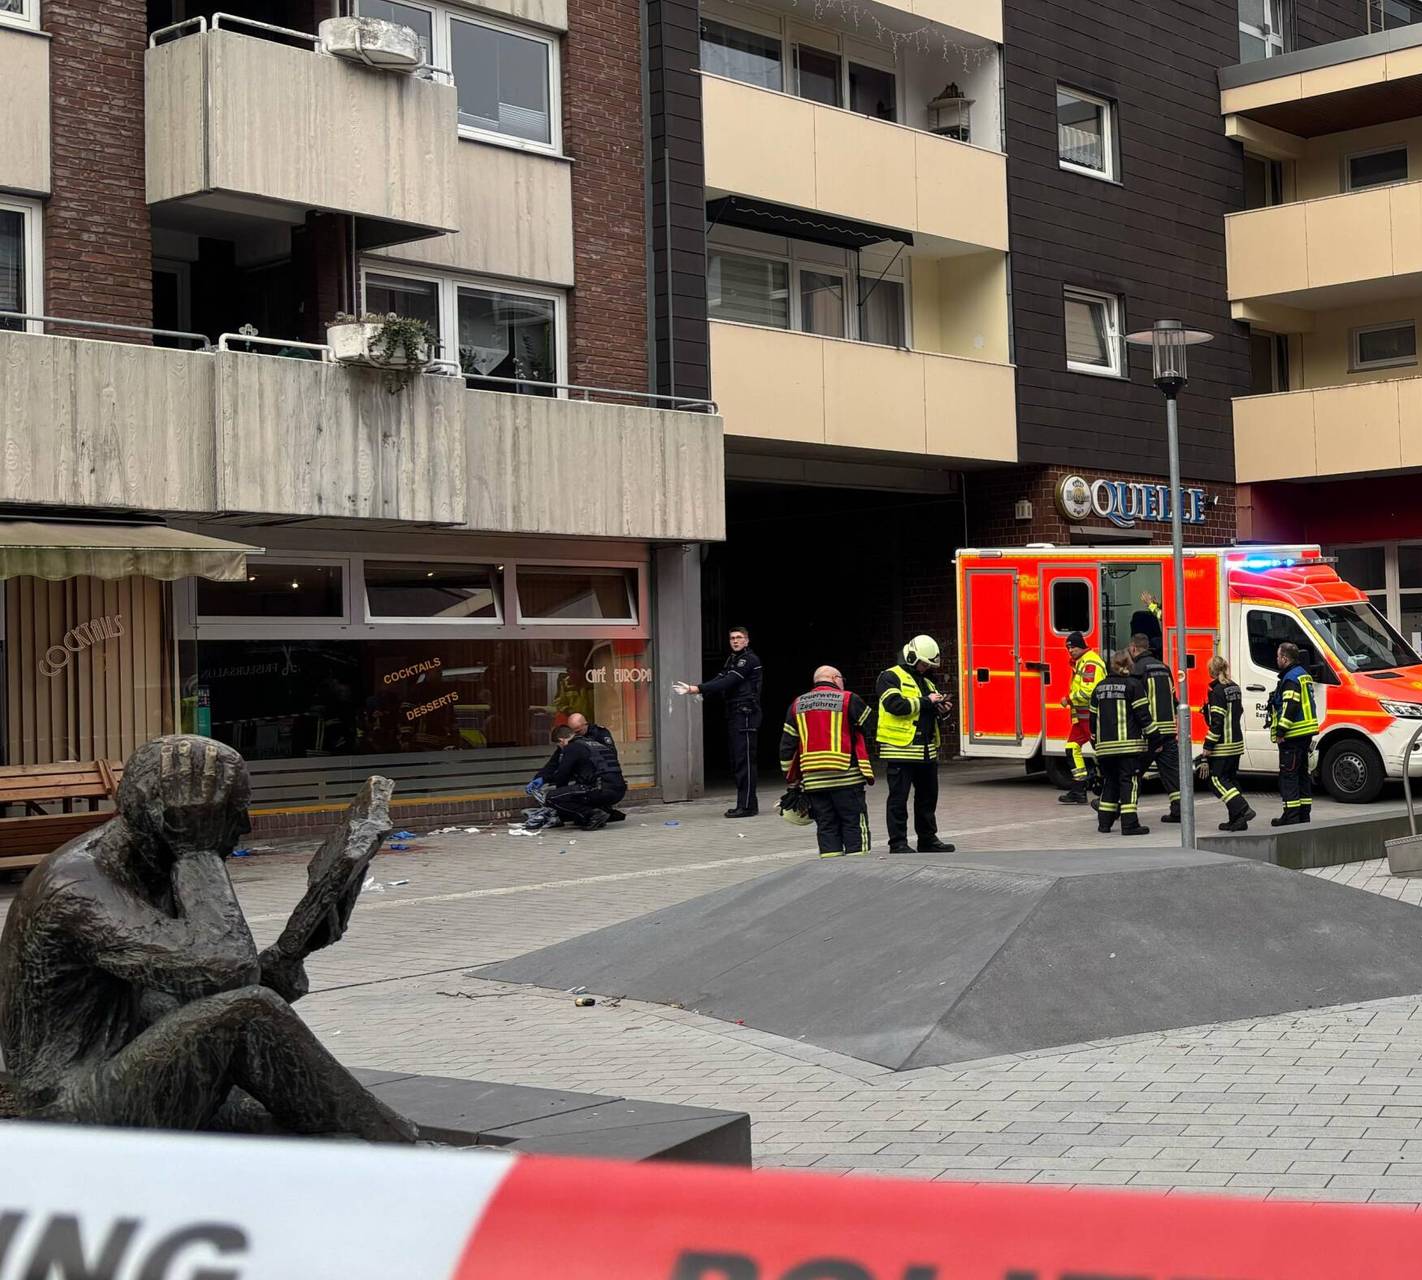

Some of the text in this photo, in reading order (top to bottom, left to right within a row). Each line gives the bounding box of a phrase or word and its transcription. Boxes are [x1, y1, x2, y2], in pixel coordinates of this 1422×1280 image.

[1091, 479, 1206, 528] QUELLE
[39, 615, 124, 676] COCKTAILS
[384, 657, 441, 684] COCKTAILS
[614, 668, 652, 682] EUROPA
[406, 691, 459, 720] DESSERTS
[800, 692, 841, 700] Feuerwehr
[800, 701, 838, 710] Zugführer
